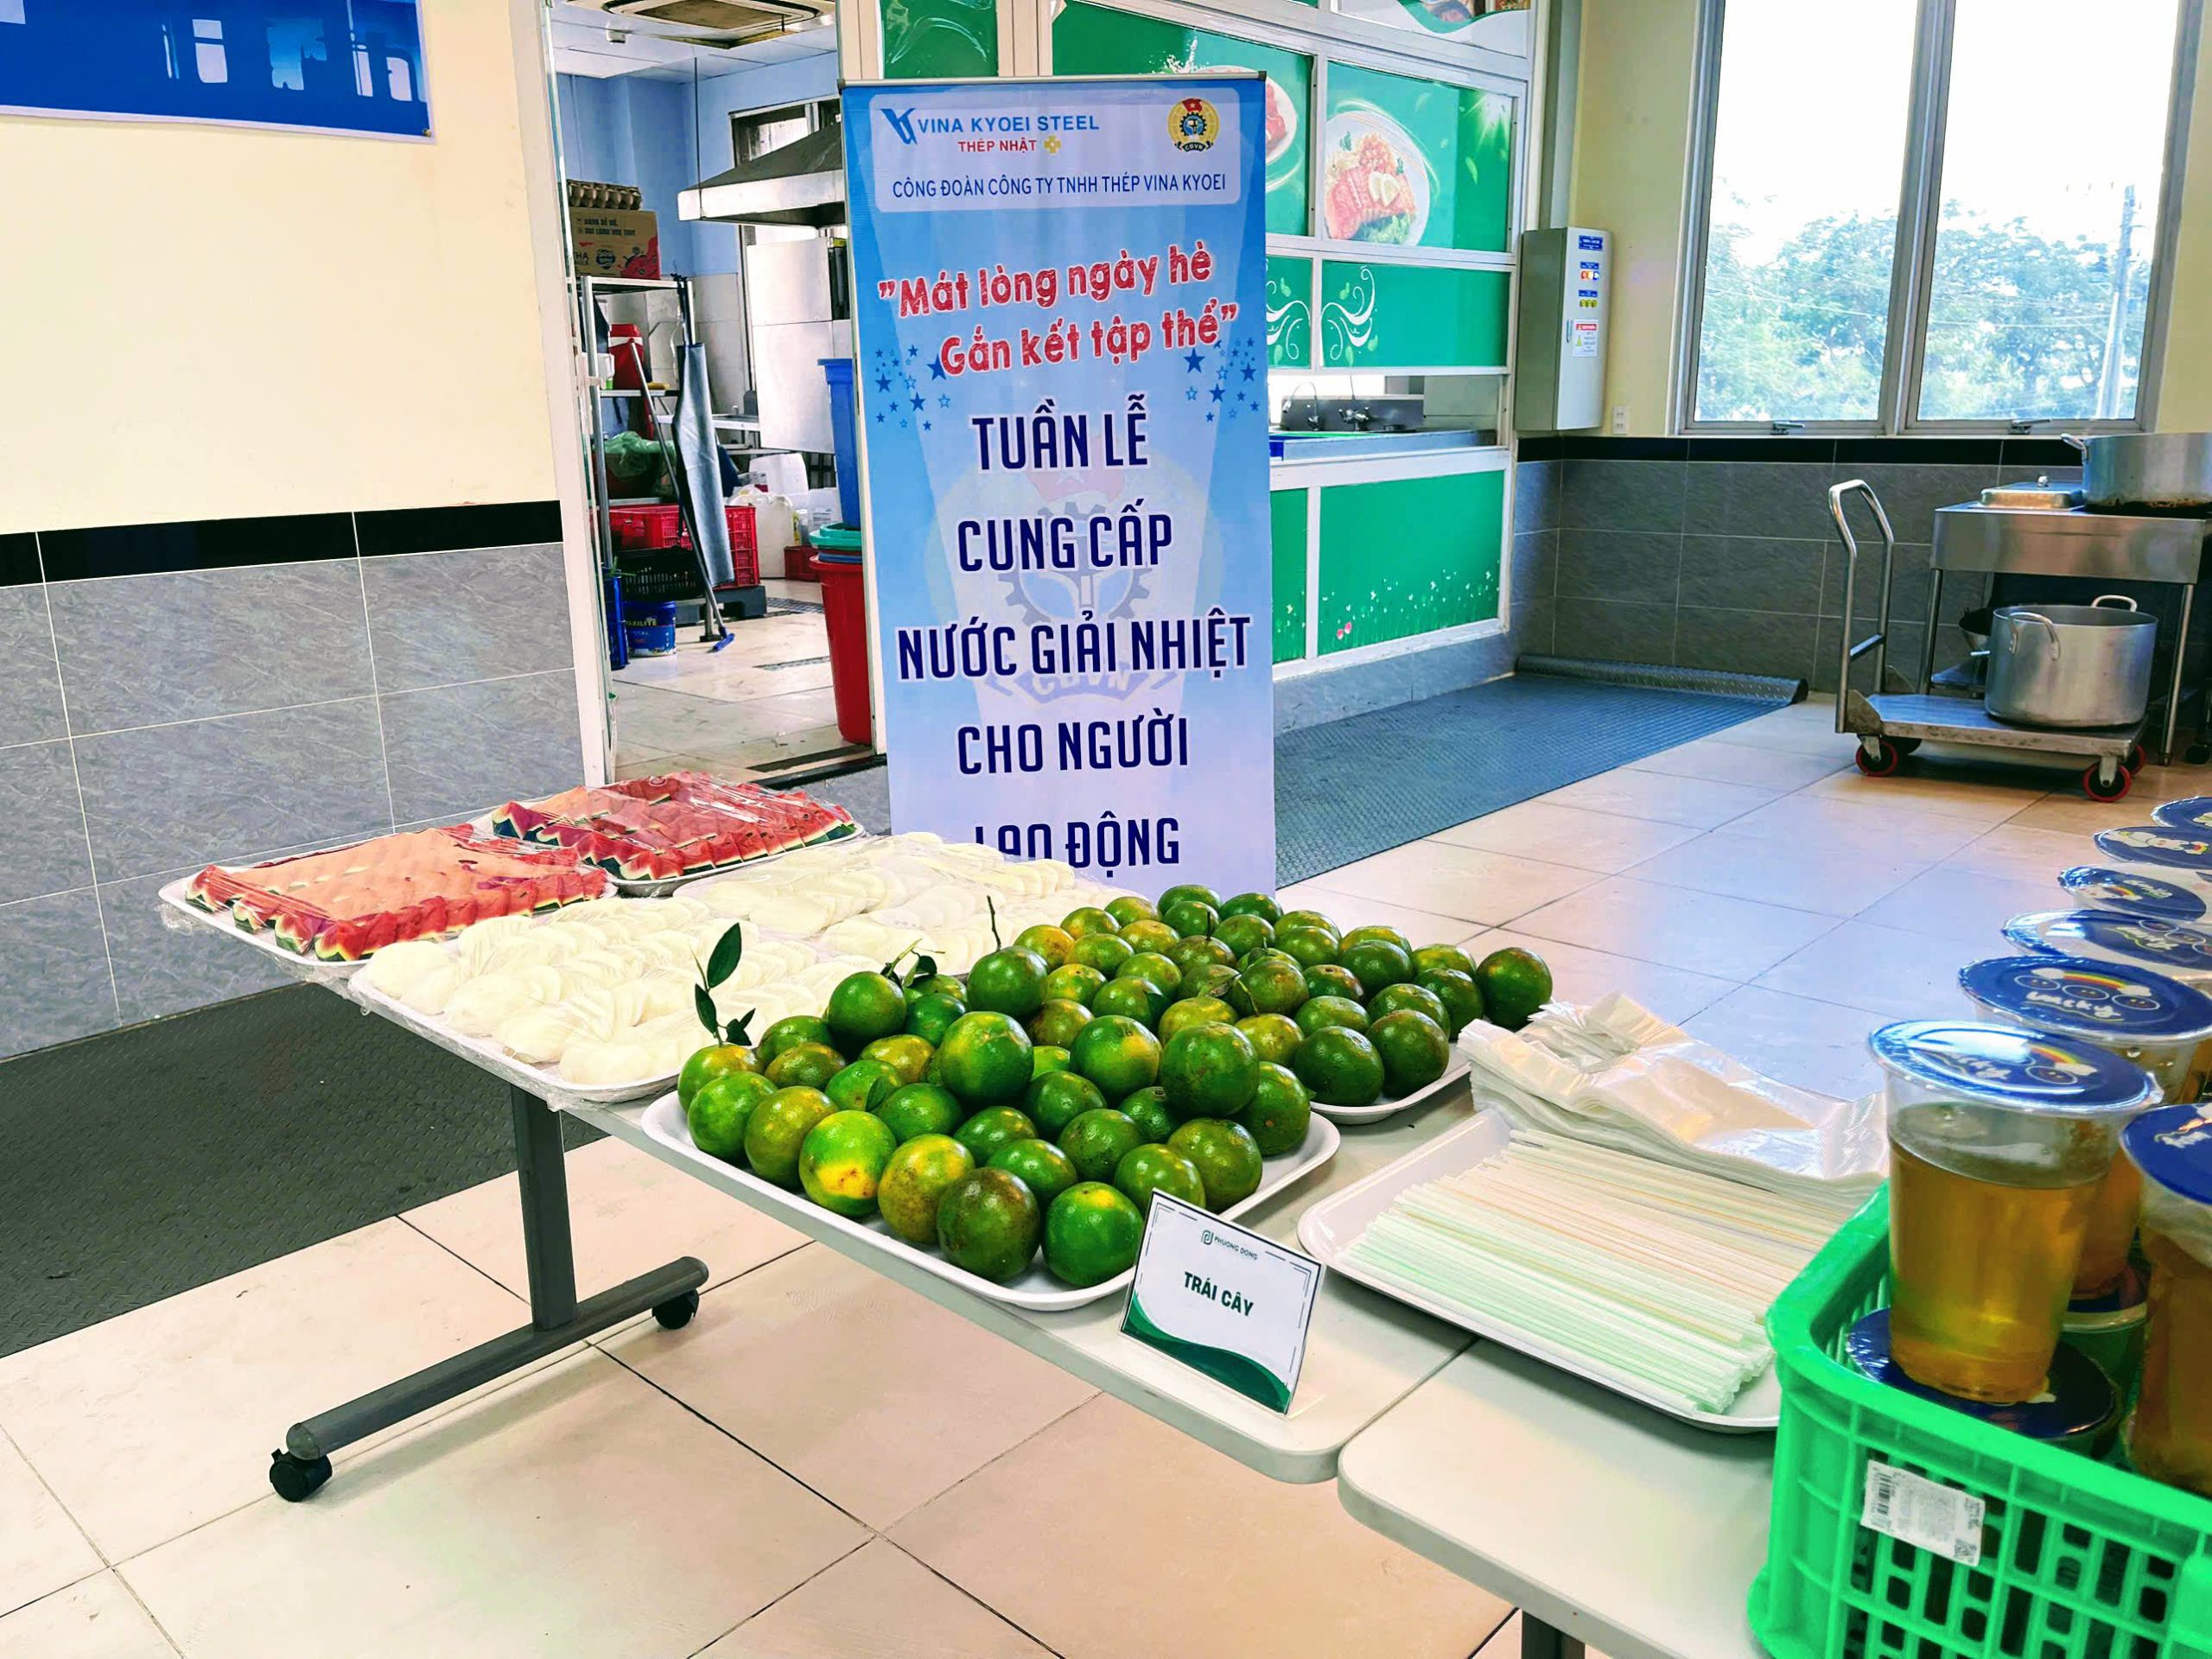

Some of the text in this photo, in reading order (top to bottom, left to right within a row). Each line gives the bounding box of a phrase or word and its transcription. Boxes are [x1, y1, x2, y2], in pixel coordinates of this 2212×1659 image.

[918, 116, 1099, 133] VINA KYOEI STEEL
[957, 137, 1037, 153] THÉP NHẬT
[893, 172, 1224, 198] CÔNG ĐOÀN CÔNG TY TNHH THÉP VINA KYOEI
[978, 264, 1058, 308] lòng
[1067, 249, 1159, 299] ngày
[1169, 240, 1212, 284] hè
[940, 326, 1012, 376] Gắn
[1020, 317, 1081, 367] kết
[1090, 315, 1152, 365] tập
[971, 393, 1147, 470] TUẦN LỄ
[957, 498, 1172, 572] CUNG CẤP
[898, 607, 1250, 680] NƯỚC GIẢI NHIỆT
[957, 708, 1188, 775] CHO NGƯỜI
[1065, 810, 1179, 878] ĐỘNG
[1184, 1271, 1255, 1317] TRÁI CÂY
